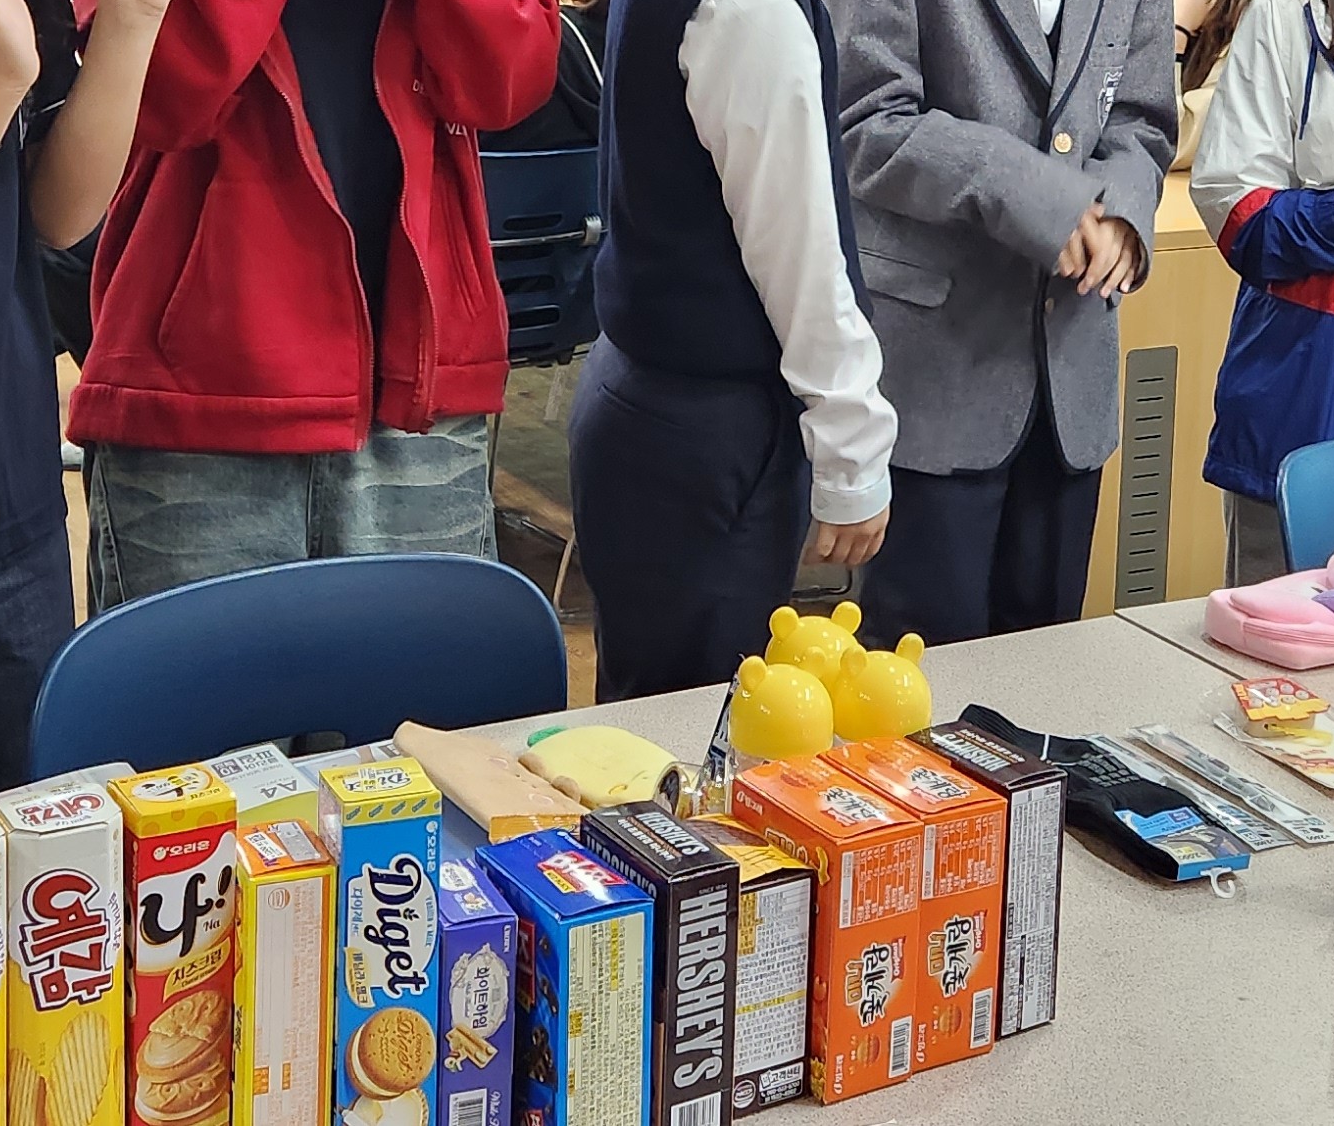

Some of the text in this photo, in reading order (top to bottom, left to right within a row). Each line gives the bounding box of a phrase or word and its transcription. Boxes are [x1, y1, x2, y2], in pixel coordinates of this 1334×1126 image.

[17, 793, 104, 826] 예감
[259, 778, 298, 799] A4
[170, 840, 211, 857] 오리온
[426, 835, 437, 873] 오리온
[635, 811, 710, 856] HERSHEY'S
[140, 865, 233, 959] 나!
[203, 917, 221, 932] Na
[351, 887, 364, 922] 다이제
[24, 870, 113, 1009] 예감
[363, 857, 428, 995] Diget
[172, 947, 223, 986] 치즈크림
[929, 933, 946, 974] 미니
[942, 915, 973, 996] 꽃게랑
[472, 966, 491, 1029] 화이트하임
[673, 889, 728, 1088] HERSHEY'S
[846, 960, 863, 1004] 미니
[859, 941, 890, 1025] 꽃게랑
[769, 1065, 801, 1084] 고객센터
